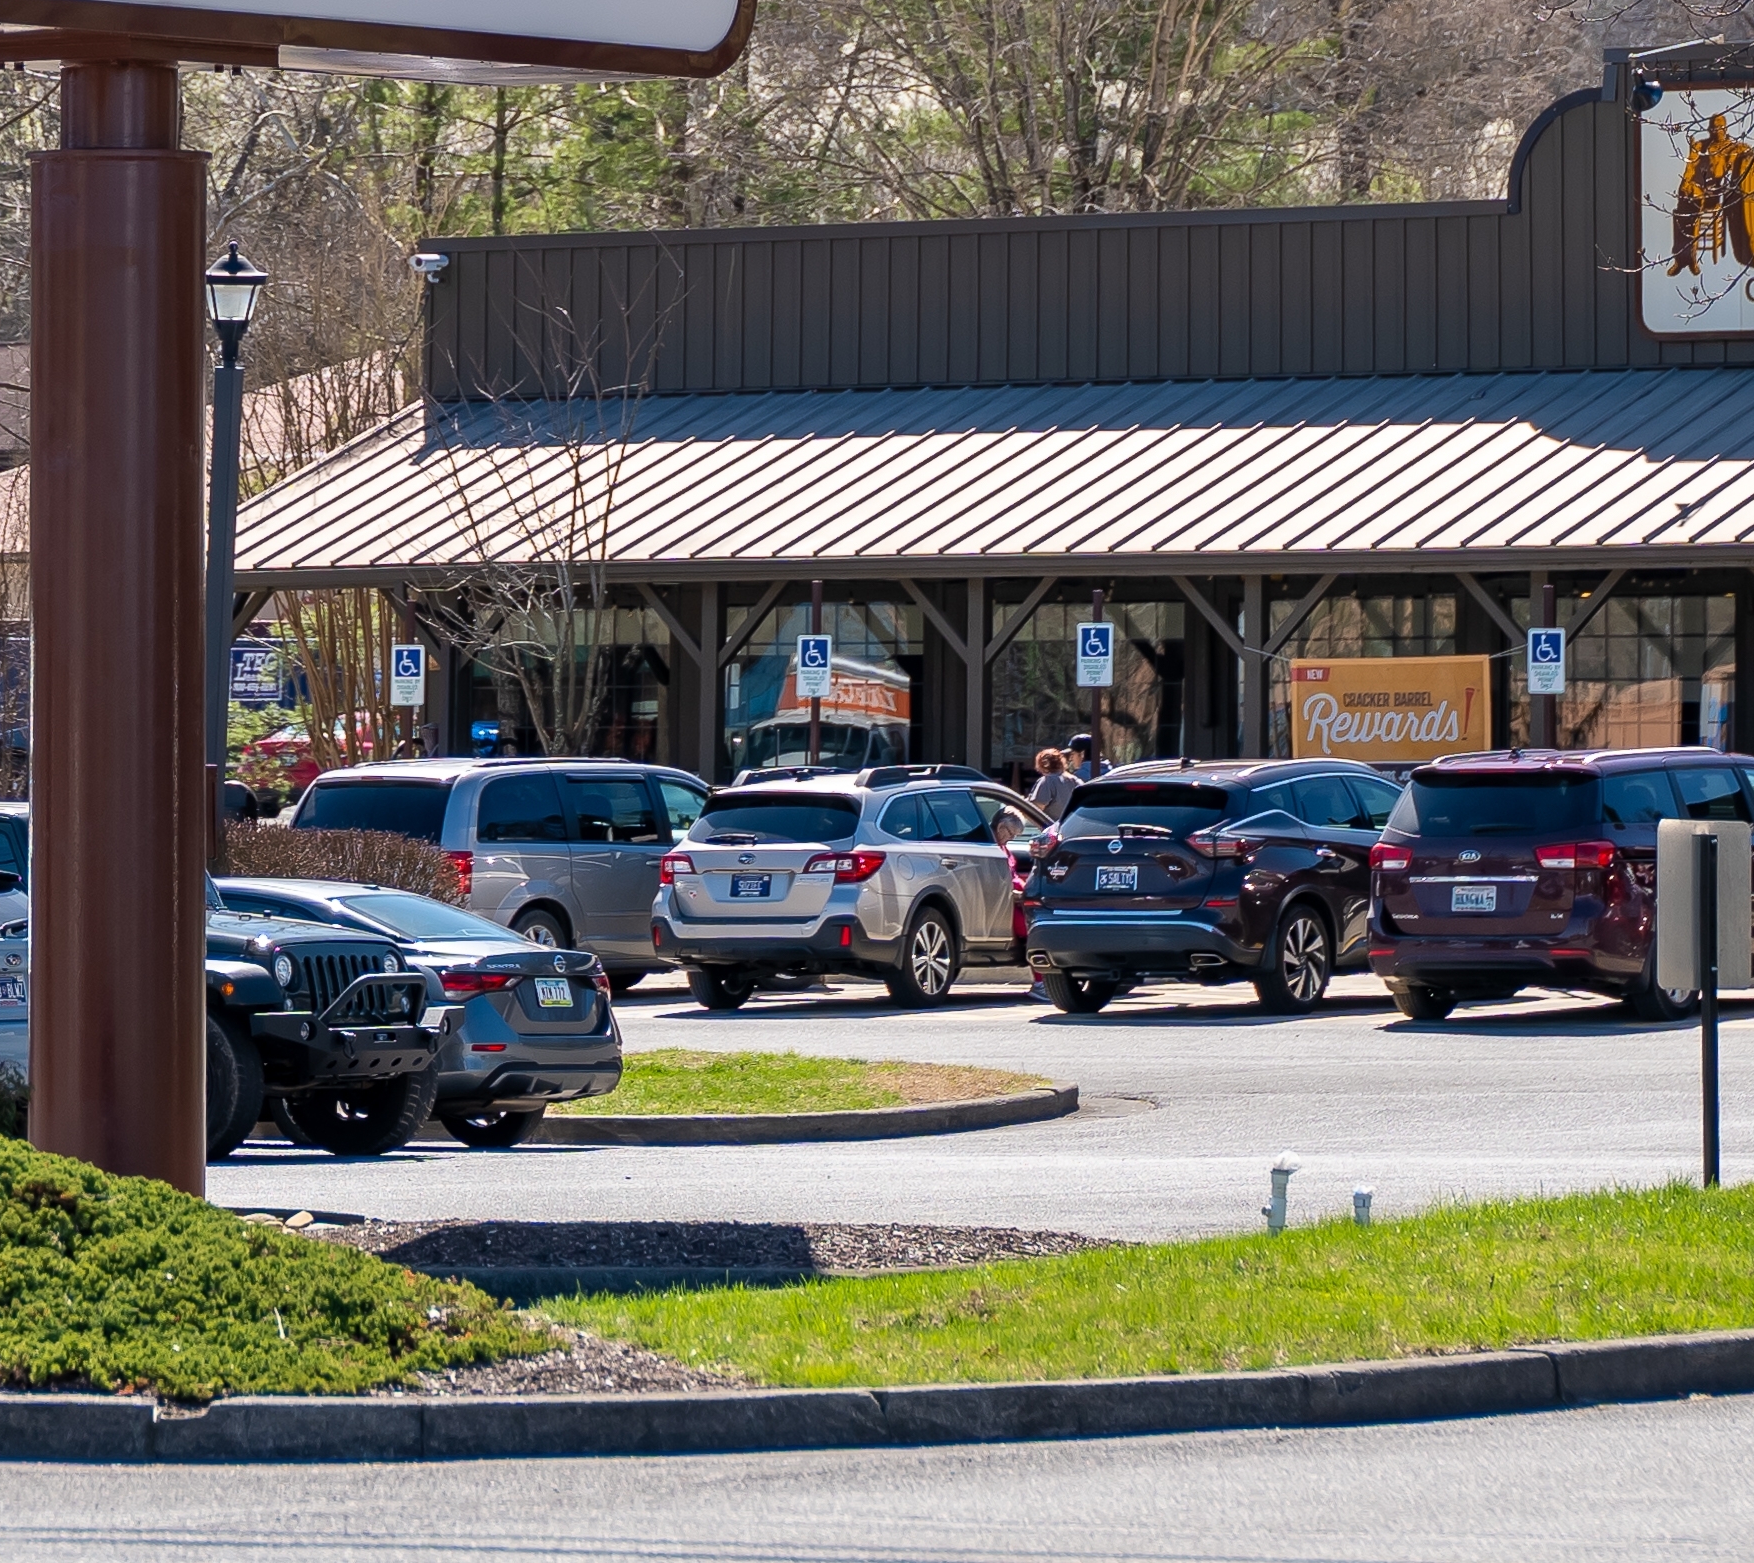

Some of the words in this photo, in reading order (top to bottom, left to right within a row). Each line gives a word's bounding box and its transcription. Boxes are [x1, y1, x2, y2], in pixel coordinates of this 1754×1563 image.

[1306, 669, 1324, 681] NEW
[1342, 692, 1390, 708] CRACKER
[1394, 691, 1434, 707] BARREL
